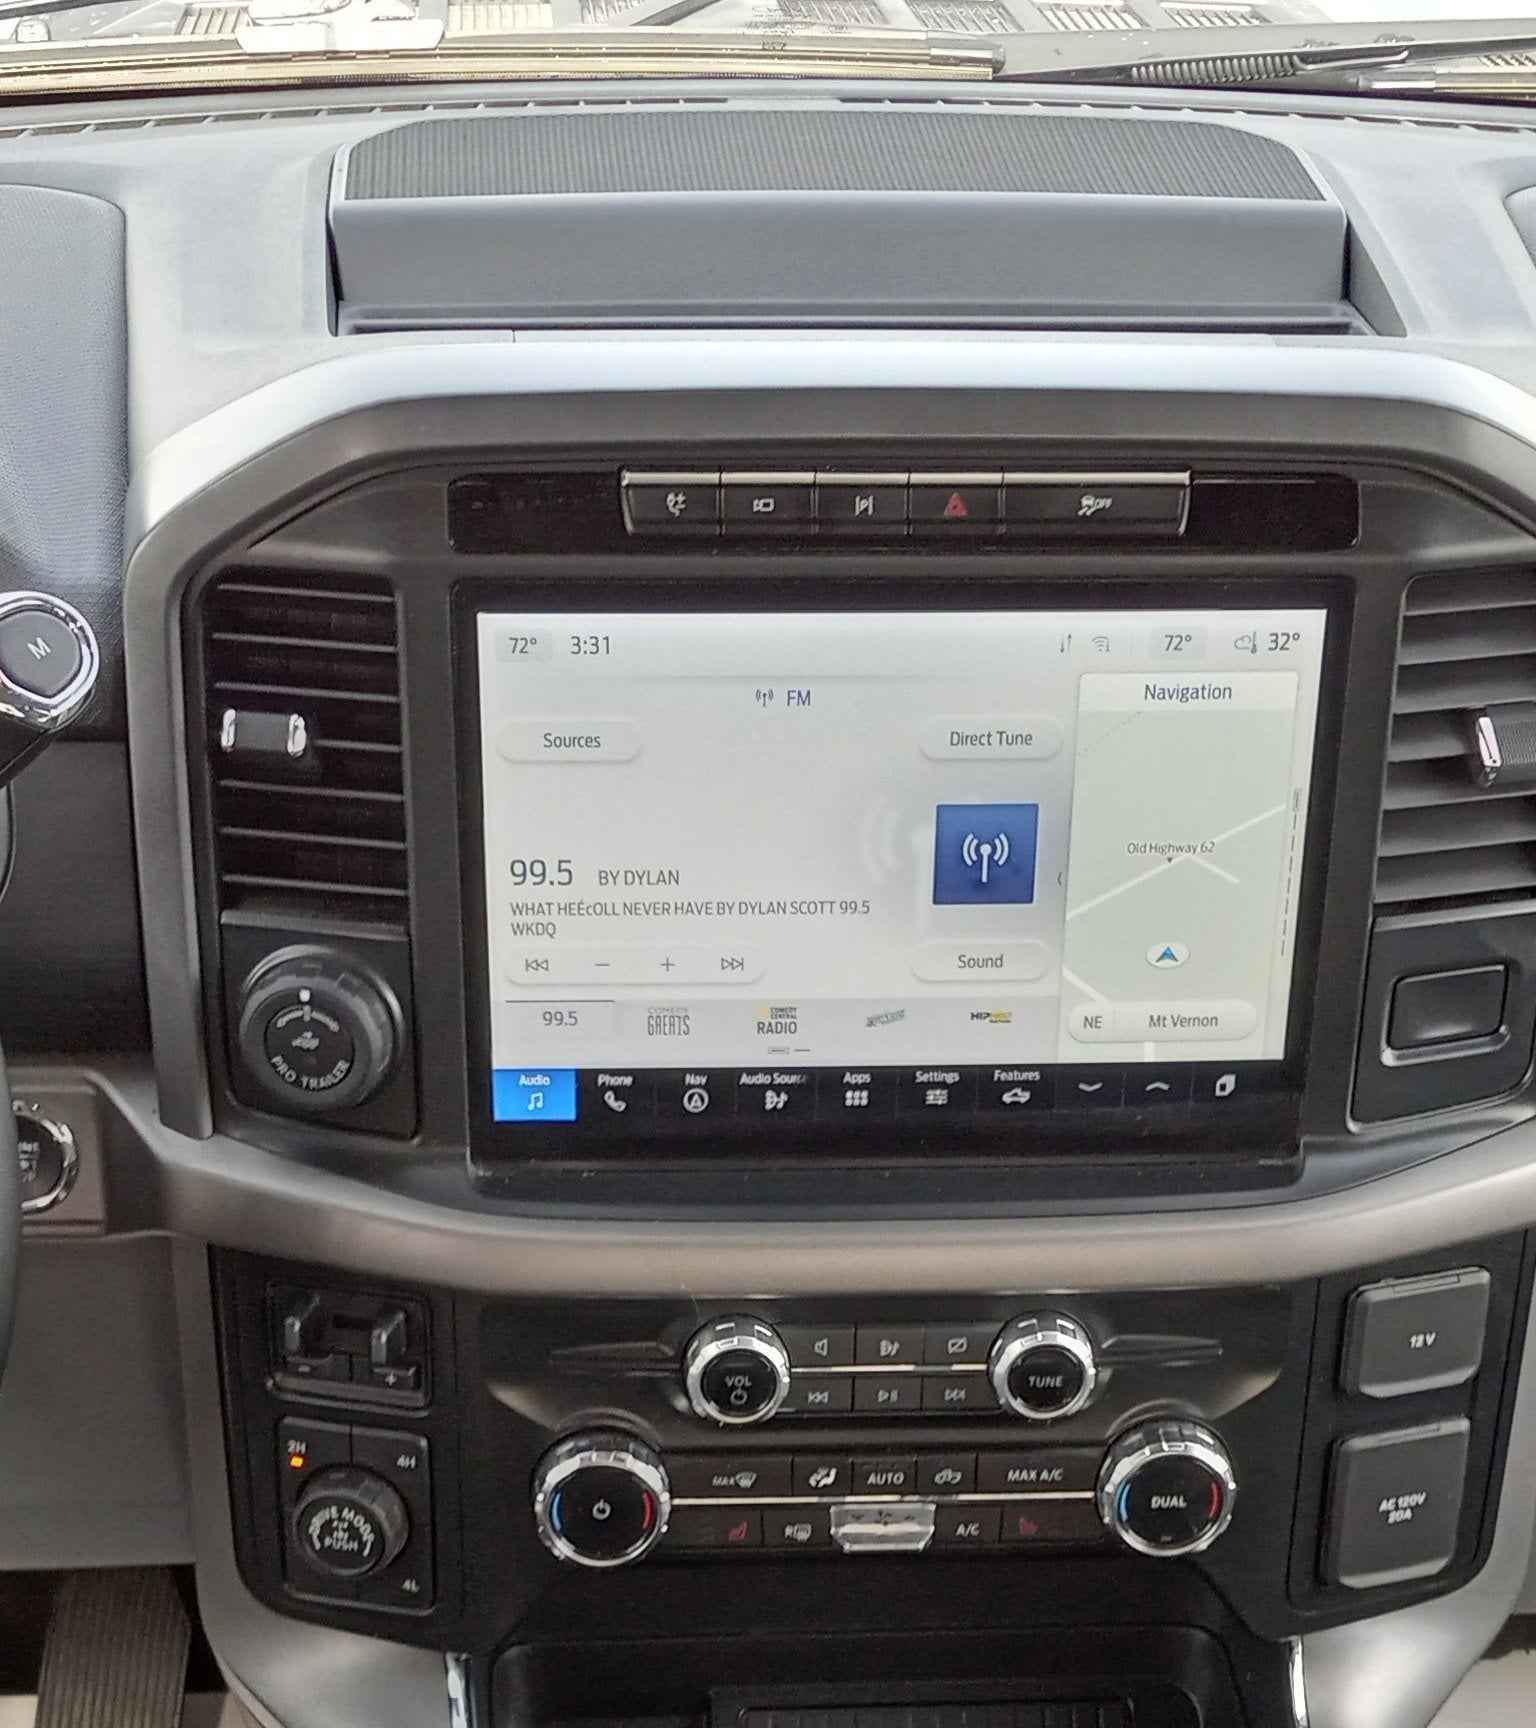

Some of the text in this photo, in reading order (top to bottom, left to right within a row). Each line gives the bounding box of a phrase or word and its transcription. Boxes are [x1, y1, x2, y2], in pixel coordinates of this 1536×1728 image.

[27, 636, 52, 660] M
[509, 637, 537, 654] 72°
[570, 635, 611, 655] 3:31
[1164, 634, 1192, 652] 72°
[1267, 632, 1300, 651] 32°
[786, 690, 811, 706] FM
[1144, 683, 1232, 703] Navigation
[543, 733, 601, 748] Sources
[949, 731, 1033, 747] Direct Tune
[1126, 841, 1215, 856] Old Highway 62
[509, 859, 573, 887] 99.5
[598, 869, 680, 886] BY DYLAN
[510, 902, 554, 916] WHAT
[623, 901, 671, 916] NEVER
[674, 901, 714, 916] HAVE
[716, 901, 735, 915] BY
[738, 900, 787, 915] DYLAN
[789, 900, 837, 915] SCOTT
[839, 900, 870, 915] 99.5
[510, 922, 556, 938] WKDQ
[957, 954, 1004, 970] Sound
[542, 1011, 578, 1027] 99.5
[1083, 1015, 1102, 1030] NE
[1148, 1013, 1219, 1028] Mt Vernon
[757, 1021, 798, 1034] RADIO
[271, 1055, 350, 1090] PRO TRAILER
[519, 1074, 551, 1086] Audio
[597, 1073, 633, 1087] Phone
[685, 1073, 707, 1086] Nav
[739, 1072, 772, 1085] Audio
[843, 1072, 871, 1087] Apps
[915, 1070, 959, 1084] Settings
[993, 1069, 1040, 1082] Features
[725, 1375, 752, 1388] VOL
[1028, 1374, 1063, 1388] TUNE
[867, 1471, 905, 1486] AUTO
[1007, 1468, 1063, 1483] MAX A/C
[1151, 1494, 1187, 1510] DUAL
[956, 1522, 980, 1537] A/C
